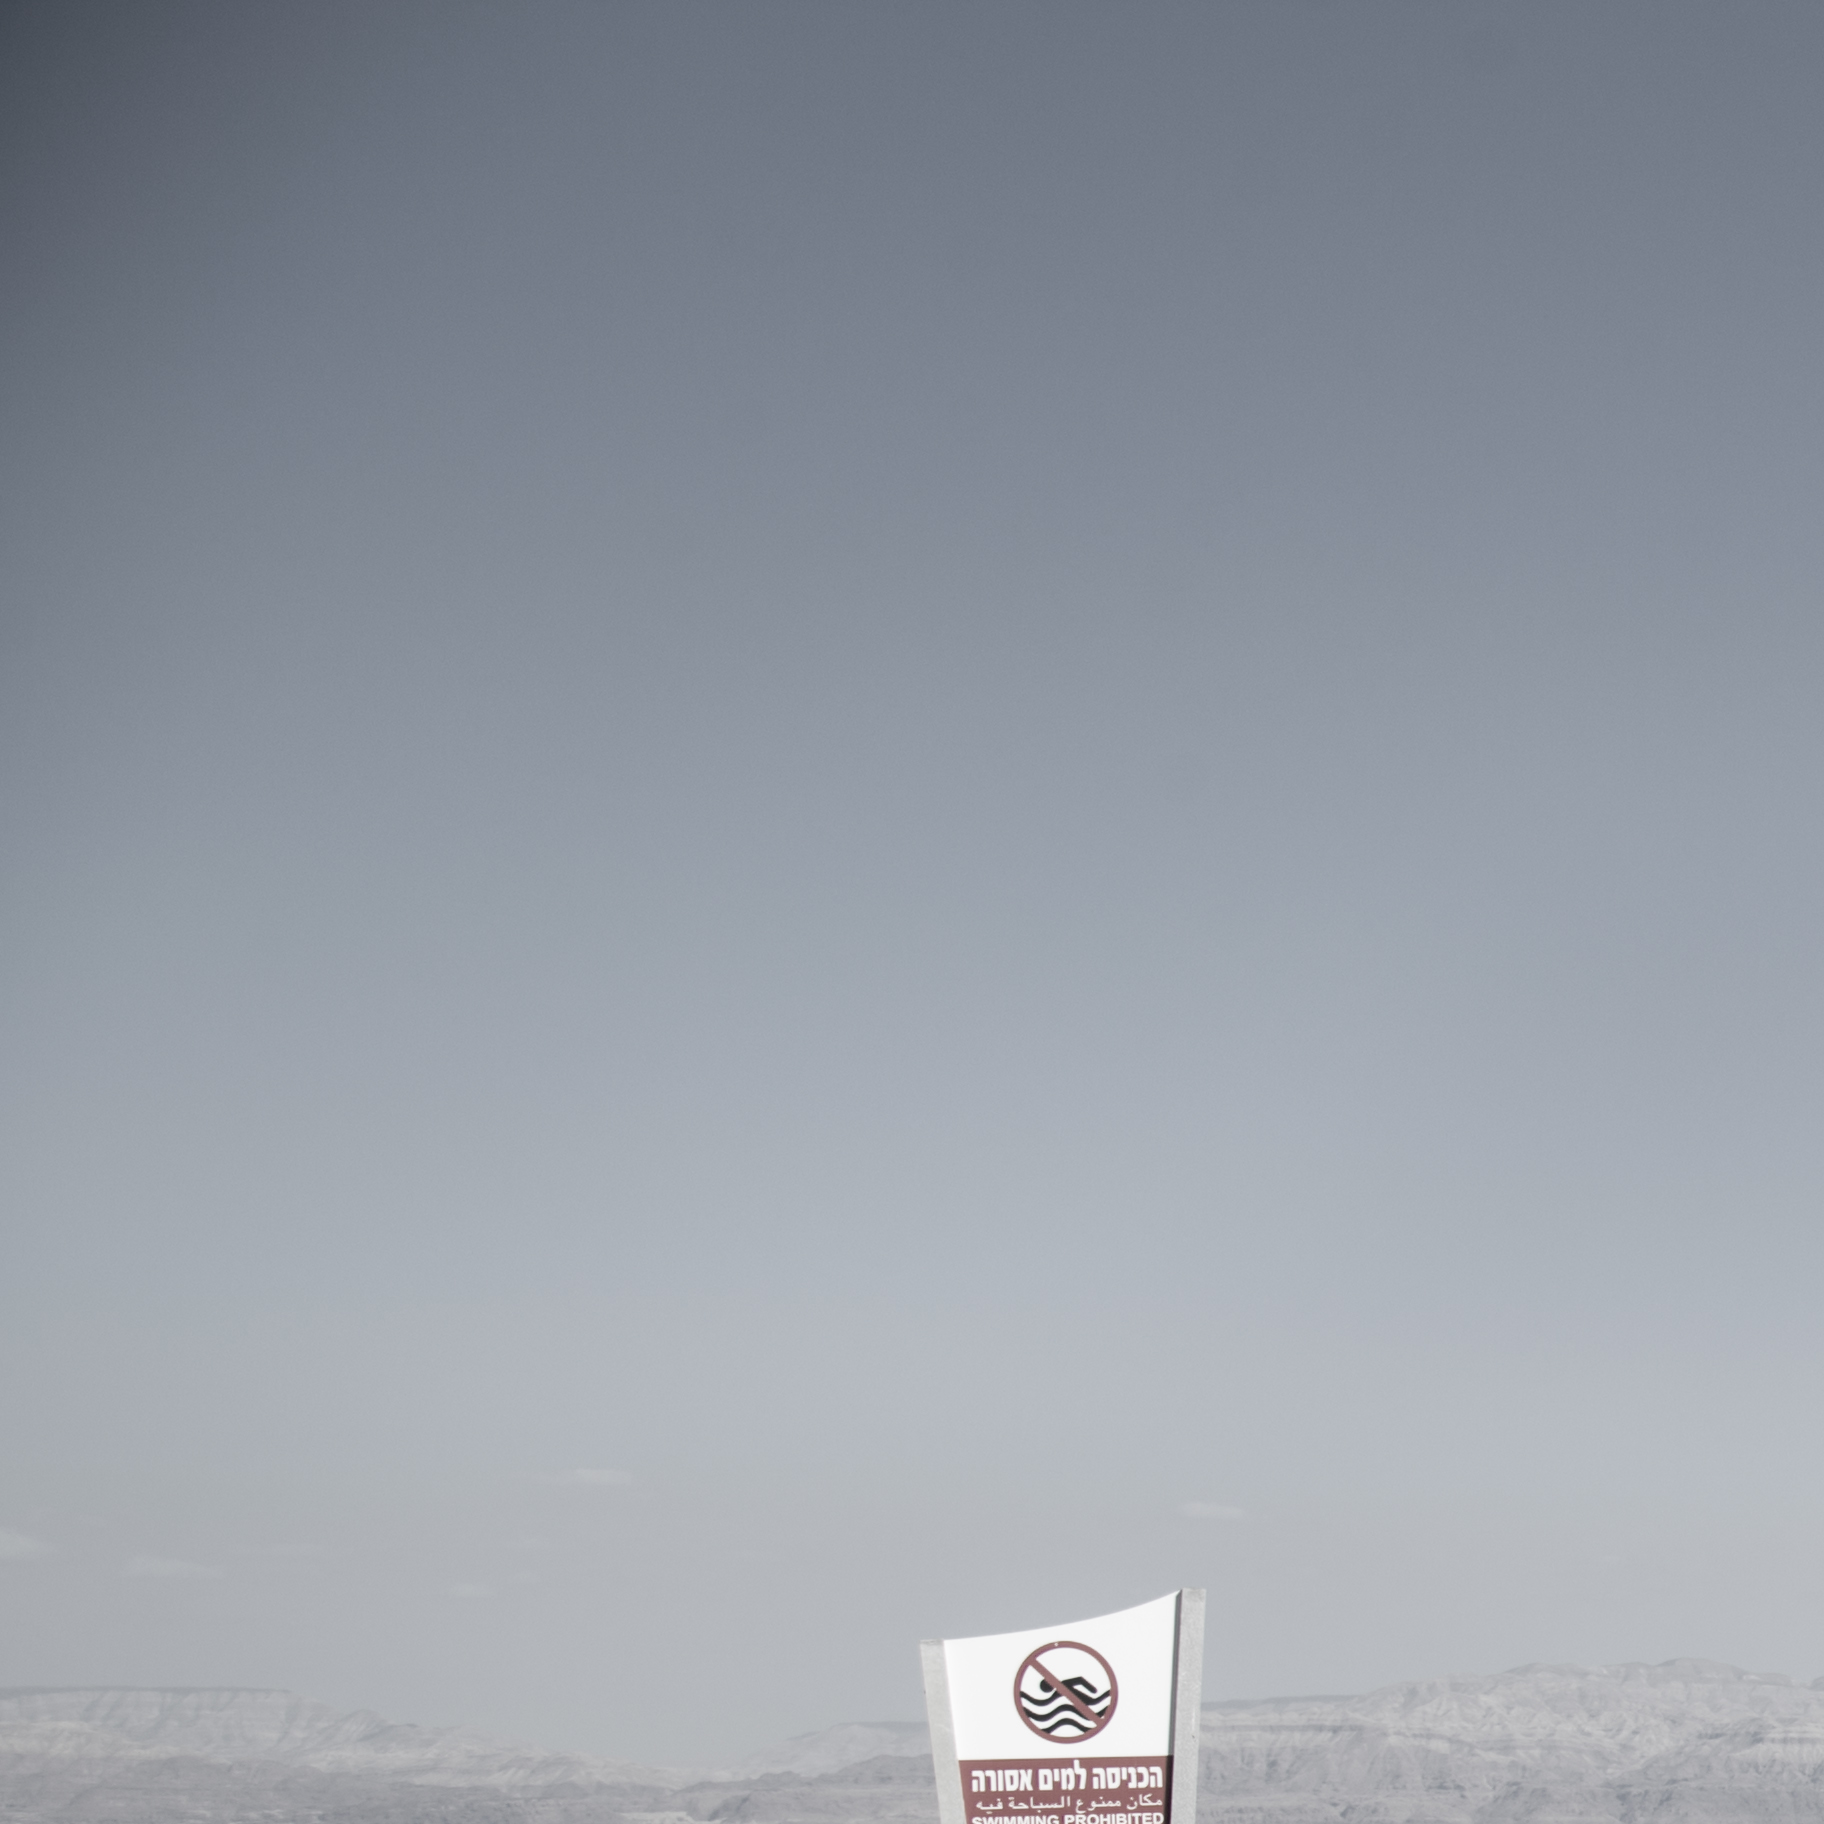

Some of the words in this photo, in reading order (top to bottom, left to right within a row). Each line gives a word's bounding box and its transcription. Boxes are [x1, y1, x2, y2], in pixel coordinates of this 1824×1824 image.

[971, 1769, 1033, 1792] אסורה
[1038, 1759, 1087, 1790] למים
[1092, 1766, 1163, 1789] הכניסה
[976, 1798, 1003, 1814] فيه
[1008, 1795, 1070, 1813] السباحة
[1075, 1796, 1121, 1814] ممنوع
[1126, 1793, 1163, 1810] مكان
